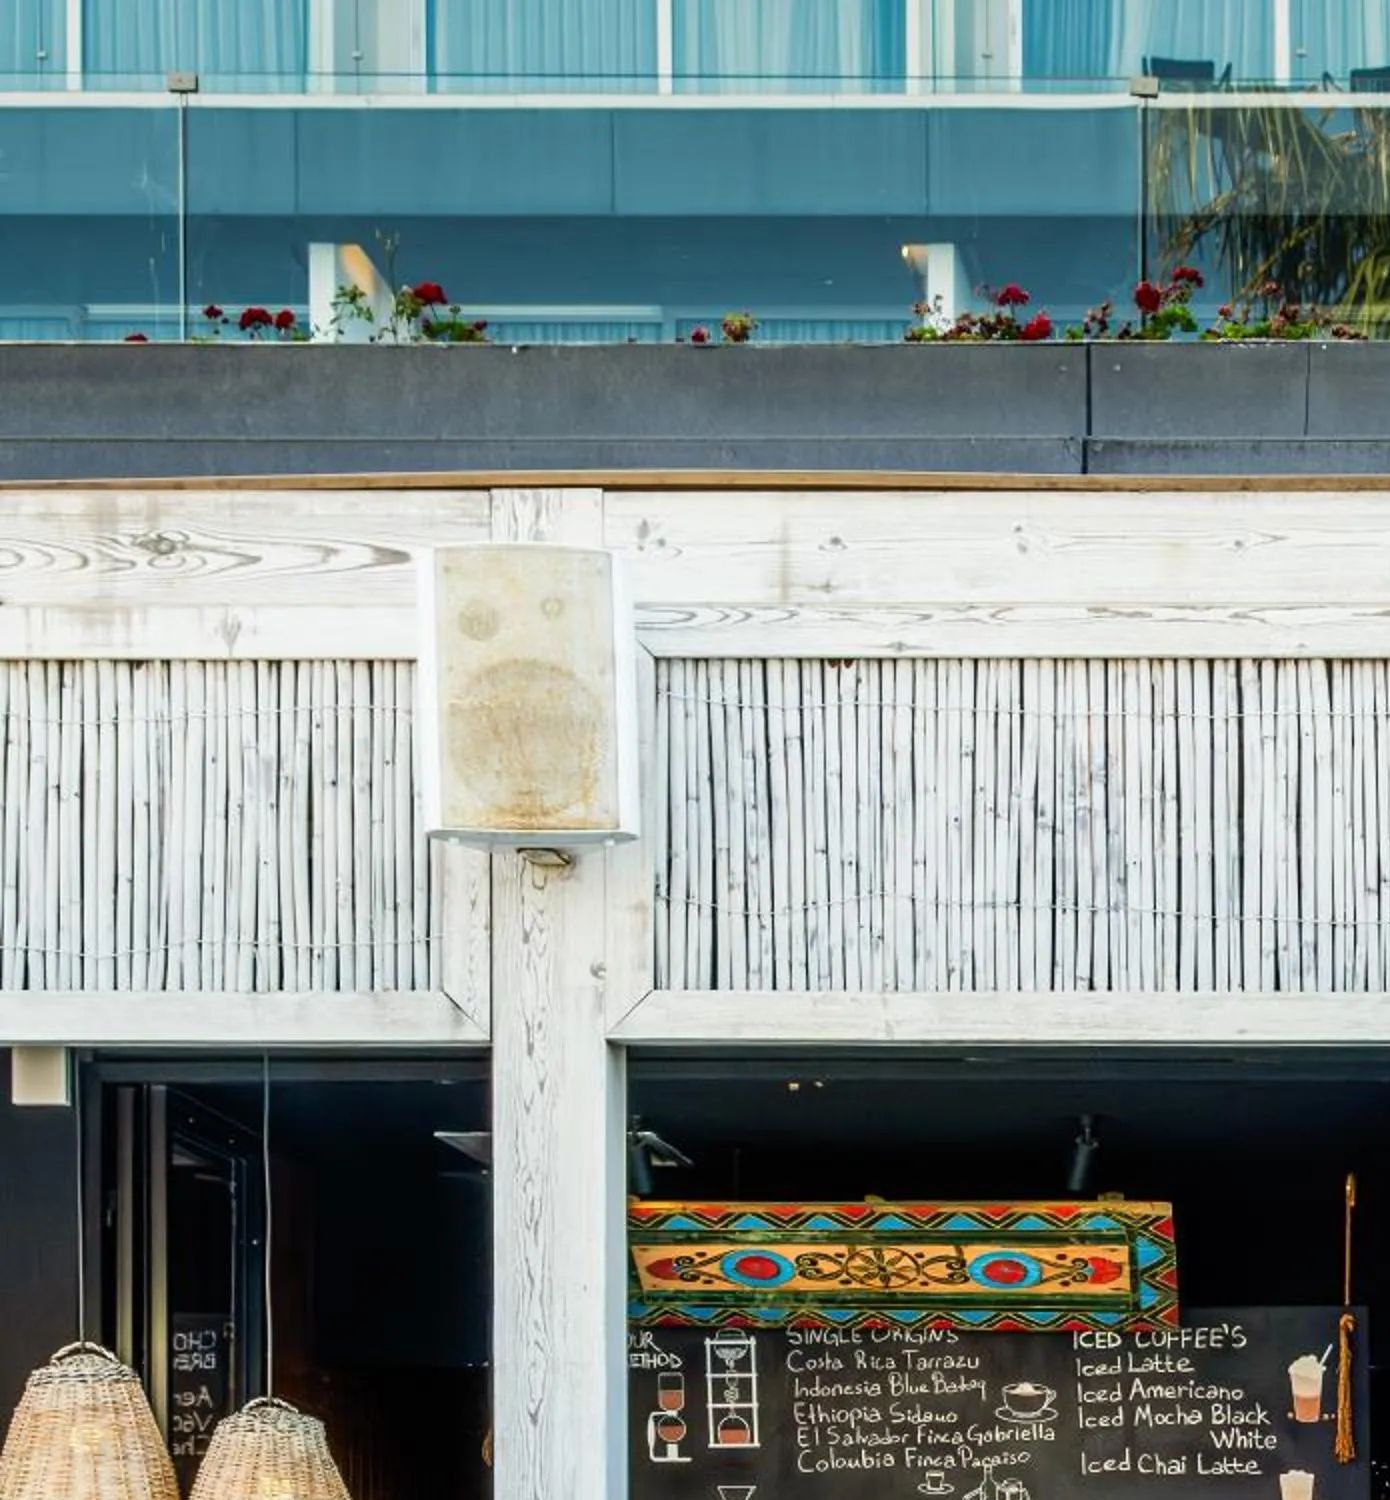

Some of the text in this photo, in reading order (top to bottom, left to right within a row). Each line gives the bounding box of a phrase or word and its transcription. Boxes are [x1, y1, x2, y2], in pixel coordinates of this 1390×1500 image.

[786, 1325, 863, 1345] SINGLE
[1073, 1324, 1248, 1350] ICED COFFEE'S
[629, 1353, 683, 1369] ETHOD
[787, 1349, 980, 1373] Costa Rica Tarrazu
[1075, 1351, 1195, 1377] Iced Latte
[794, 1377, 882, 1398] Indonesia
[888, 1371, 929, 1397] Blue
[1076, 1377, 1244, 1403] Iced Americano
[793, 1402, 882, 1428] Ethiopia
[1078, 1402, 1271, 1429] Iced Mocha Black
[797, 1426, 820, 1447] El
[826, 1425, 910, 1447] Salvador
[1209, 1427, 1278, 1450] White
[905, 1447, 956, 1469] Finca
[1081, 1448, 1263, 1476] Iced Chai Latte
